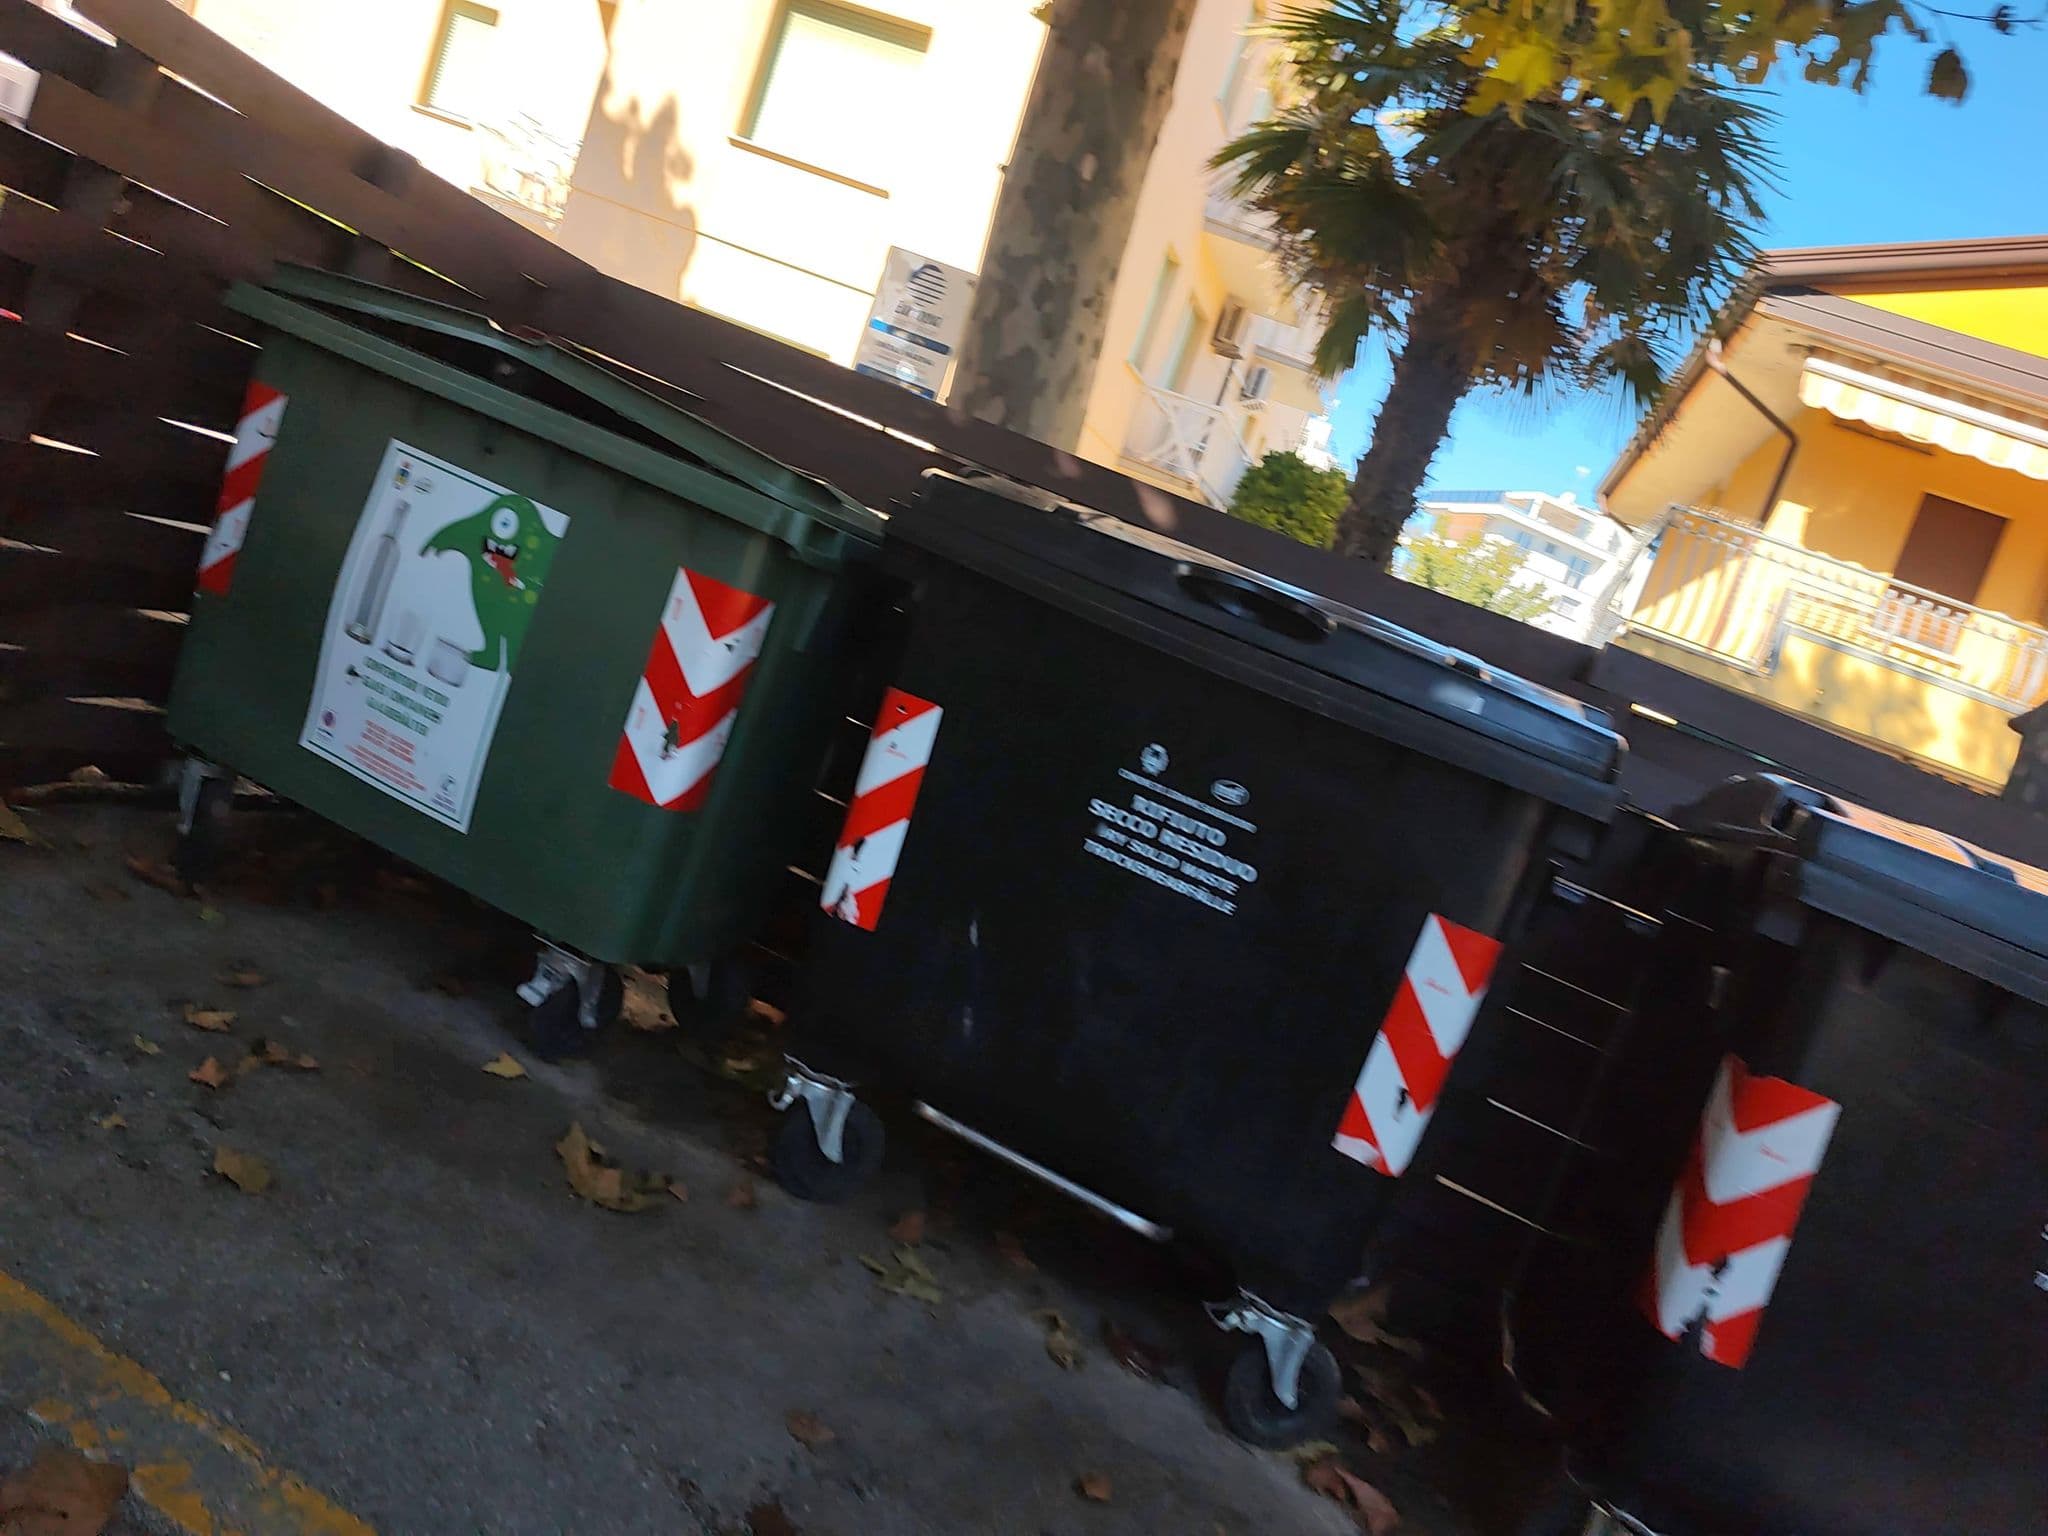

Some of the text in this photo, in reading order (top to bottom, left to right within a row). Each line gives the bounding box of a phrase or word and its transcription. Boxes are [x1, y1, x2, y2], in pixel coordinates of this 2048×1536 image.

[1088, 798, 1158, 839] SECCO
[1158, 827, 1258, 883] RESIDUO
[1131, 794, 1227, 847] RIFIUTO
[1126, 838, 1180, 869] SOLID
[1180, 860, 1240, 896] WASTE
